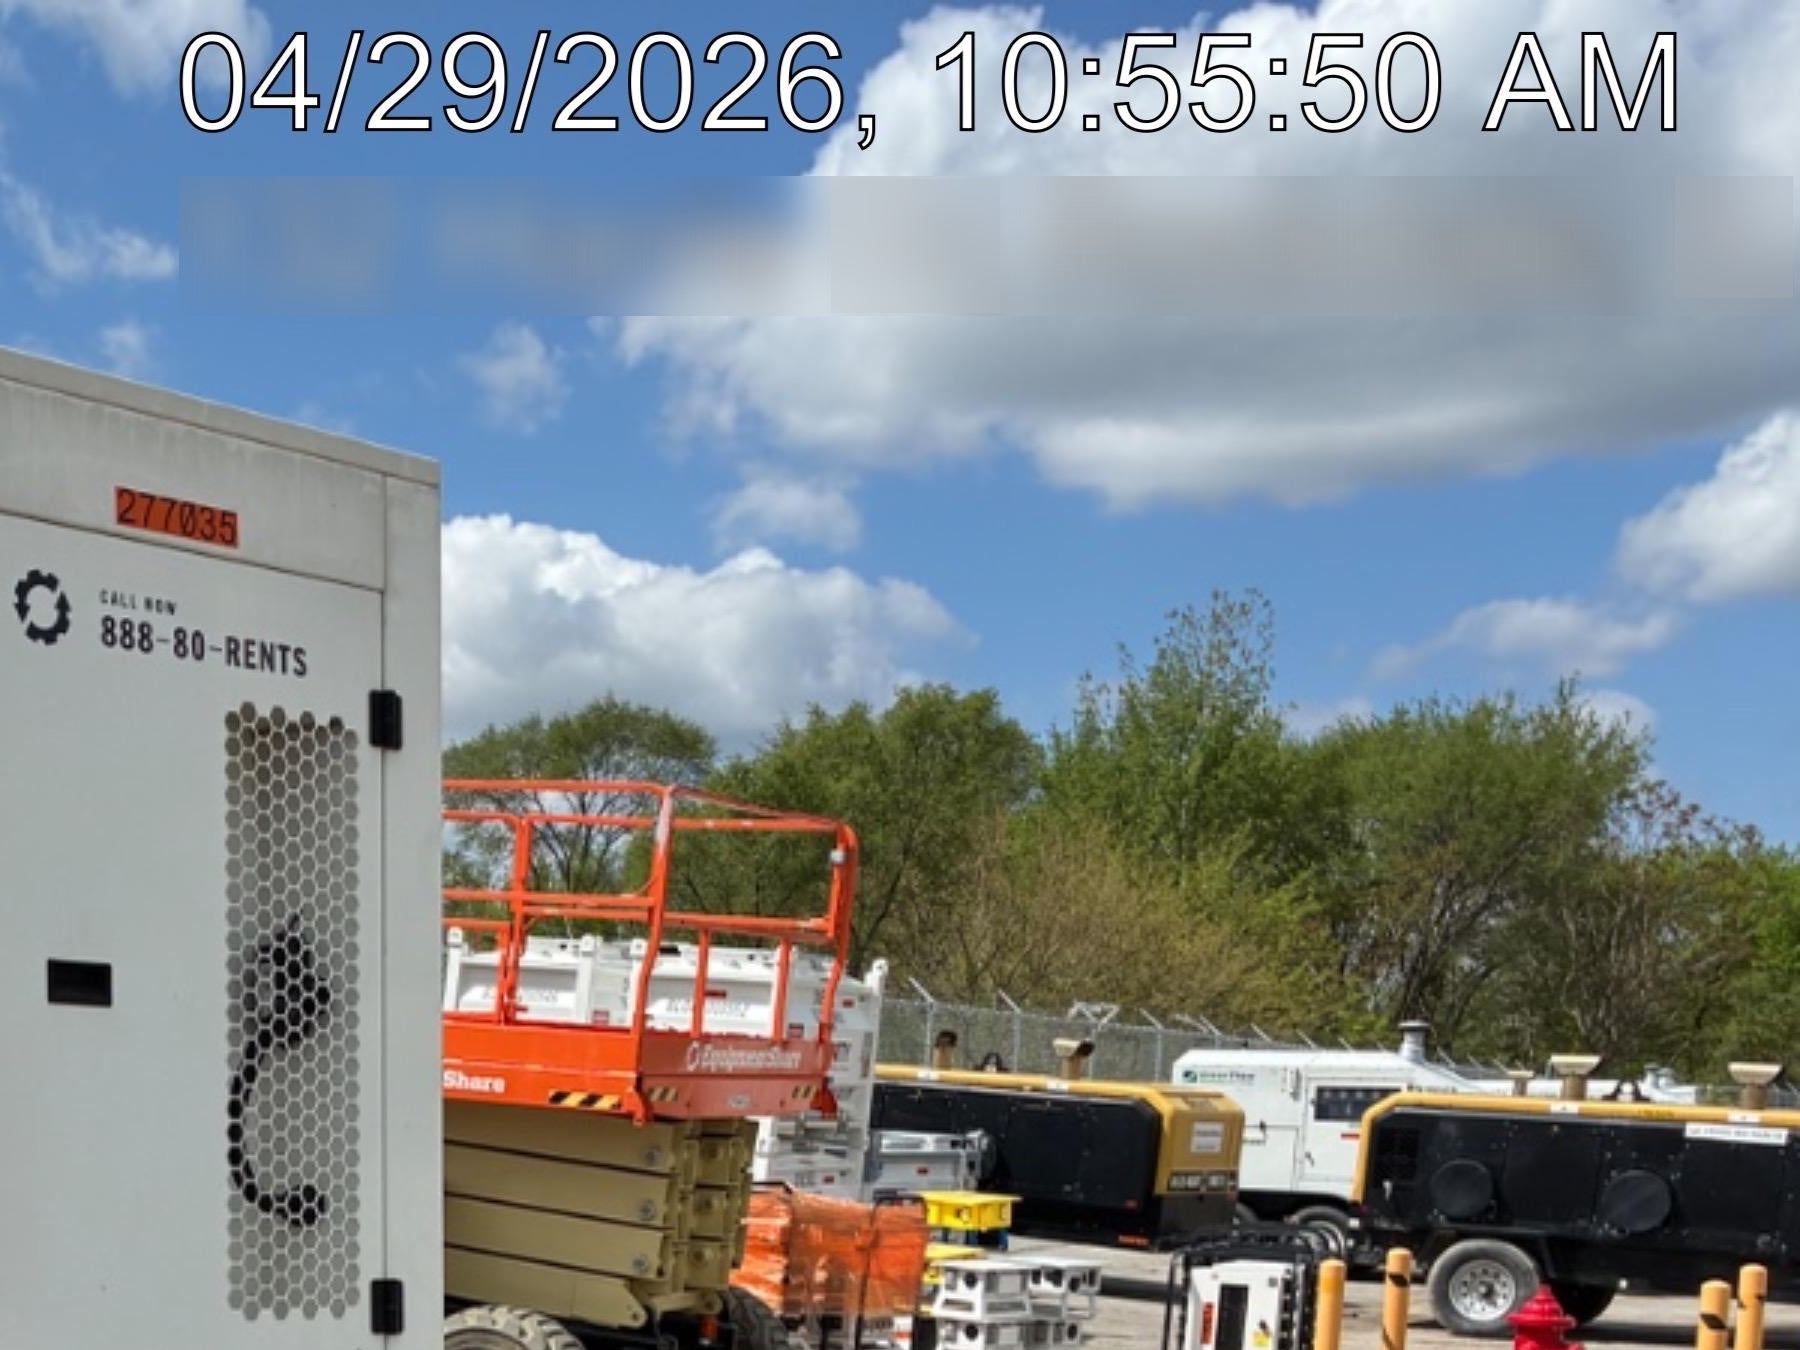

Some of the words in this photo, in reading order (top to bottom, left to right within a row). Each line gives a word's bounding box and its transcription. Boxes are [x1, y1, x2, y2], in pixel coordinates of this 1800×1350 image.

[117, 488, 238, 546] 277035
[100, 589, 137, 610] CALL
[144, 597, 177, 616] NOW
[101, 615, 307, 677] 888-80-RENTS
